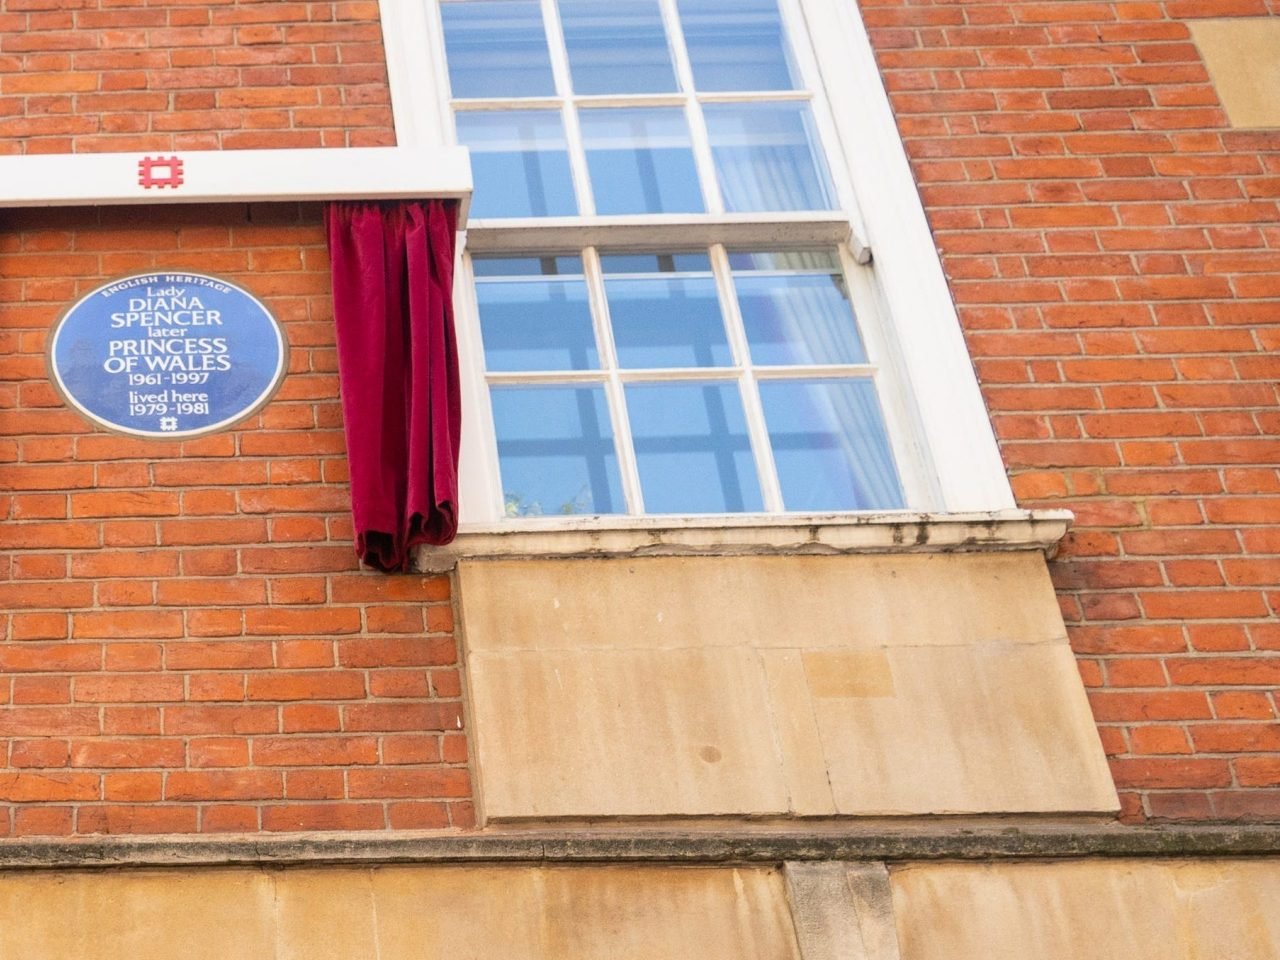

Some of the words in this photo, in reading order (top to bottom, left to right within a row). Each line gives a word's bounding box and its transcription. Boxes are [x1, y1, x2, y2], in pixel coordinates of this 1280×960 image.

[101, 276, 159, 297] ENGLISH
[166, 275, 232, 294] HERITAGE
[147, 286, 185, 297] Lady
[129, 297, 204, 312] DIANA
[111, 310, 223, 328] SPENCER
[148, 326, 188, 338] later
[109, 338, 228, 356] PRINCESS
[104, 357, 139, 374] OF
[145, 354, 231, 371] WALES
[129, 372, 210, 386] 1961-1997
[129, 390, 168, 404] lived
[171, 389, 208, 402] here
[129, 402, 209, 416] 1979-1981
